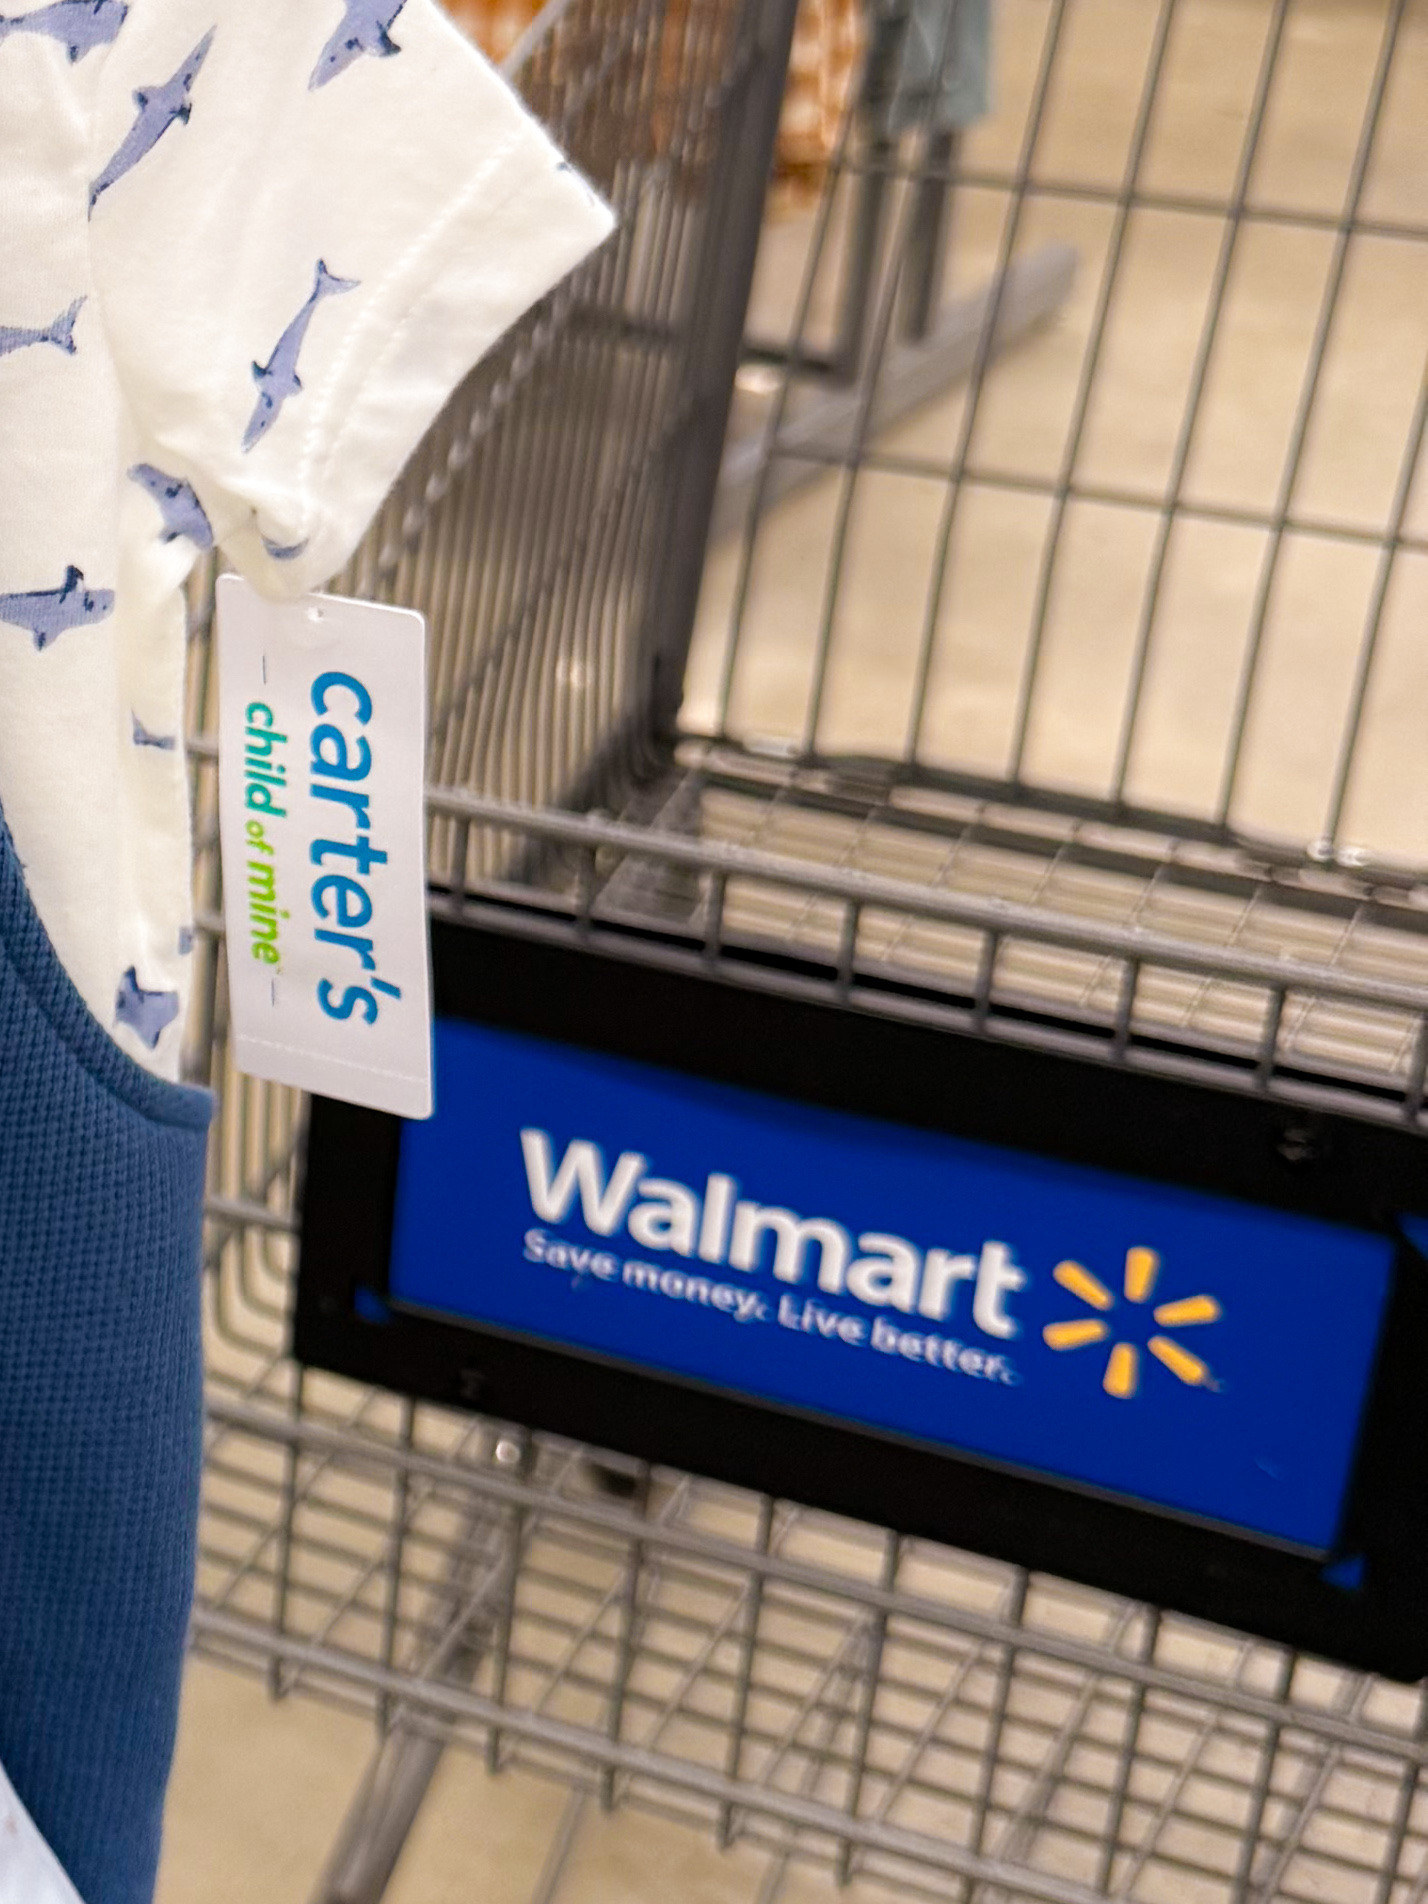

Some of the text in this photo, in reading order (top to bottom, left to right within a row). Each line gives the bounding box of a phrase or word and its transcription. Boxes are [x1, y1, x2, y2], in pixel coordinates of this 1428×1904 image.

[244, 701, 291, 966] child of mine
[309, 671, 402, 1026] carter's
[520, 1125, 1028, 1340] Walmart
[522, 1226, 621, 1282] Save
[777, 1293, 870, 1348] Live
